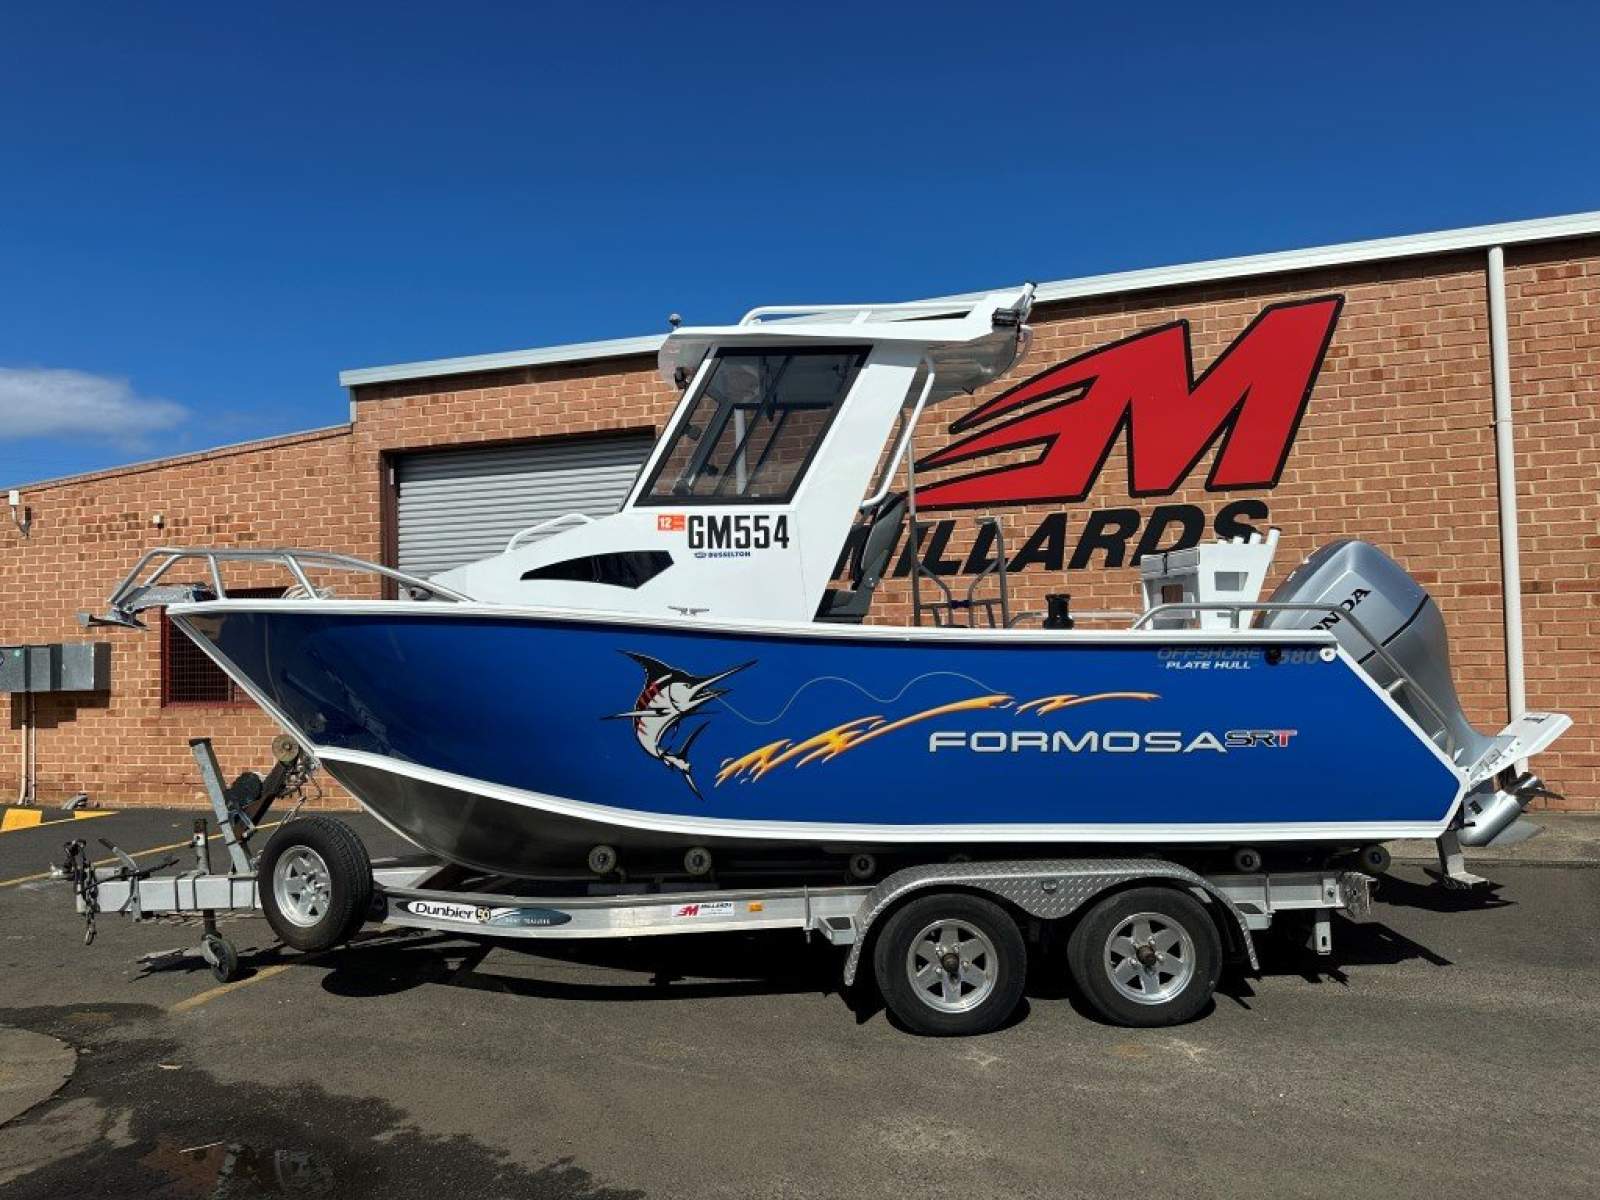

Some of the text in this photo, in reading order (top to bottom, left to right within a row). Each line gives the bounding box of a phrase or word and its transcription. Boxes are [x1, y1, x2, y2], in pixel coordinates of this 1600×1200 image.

[660, 515, 673, 529] 12
[687, 515, 789, 549] GM554
[1310, 588, 1371, 630] NDA
[1157, 647, 1261, 660] OFFSHORE
[1165, 660, 1251, 670] PLATE HULL
[928, 729, 1298, 753] FORMOSA SRT
[415, 902, 474, 919] Dunbier
